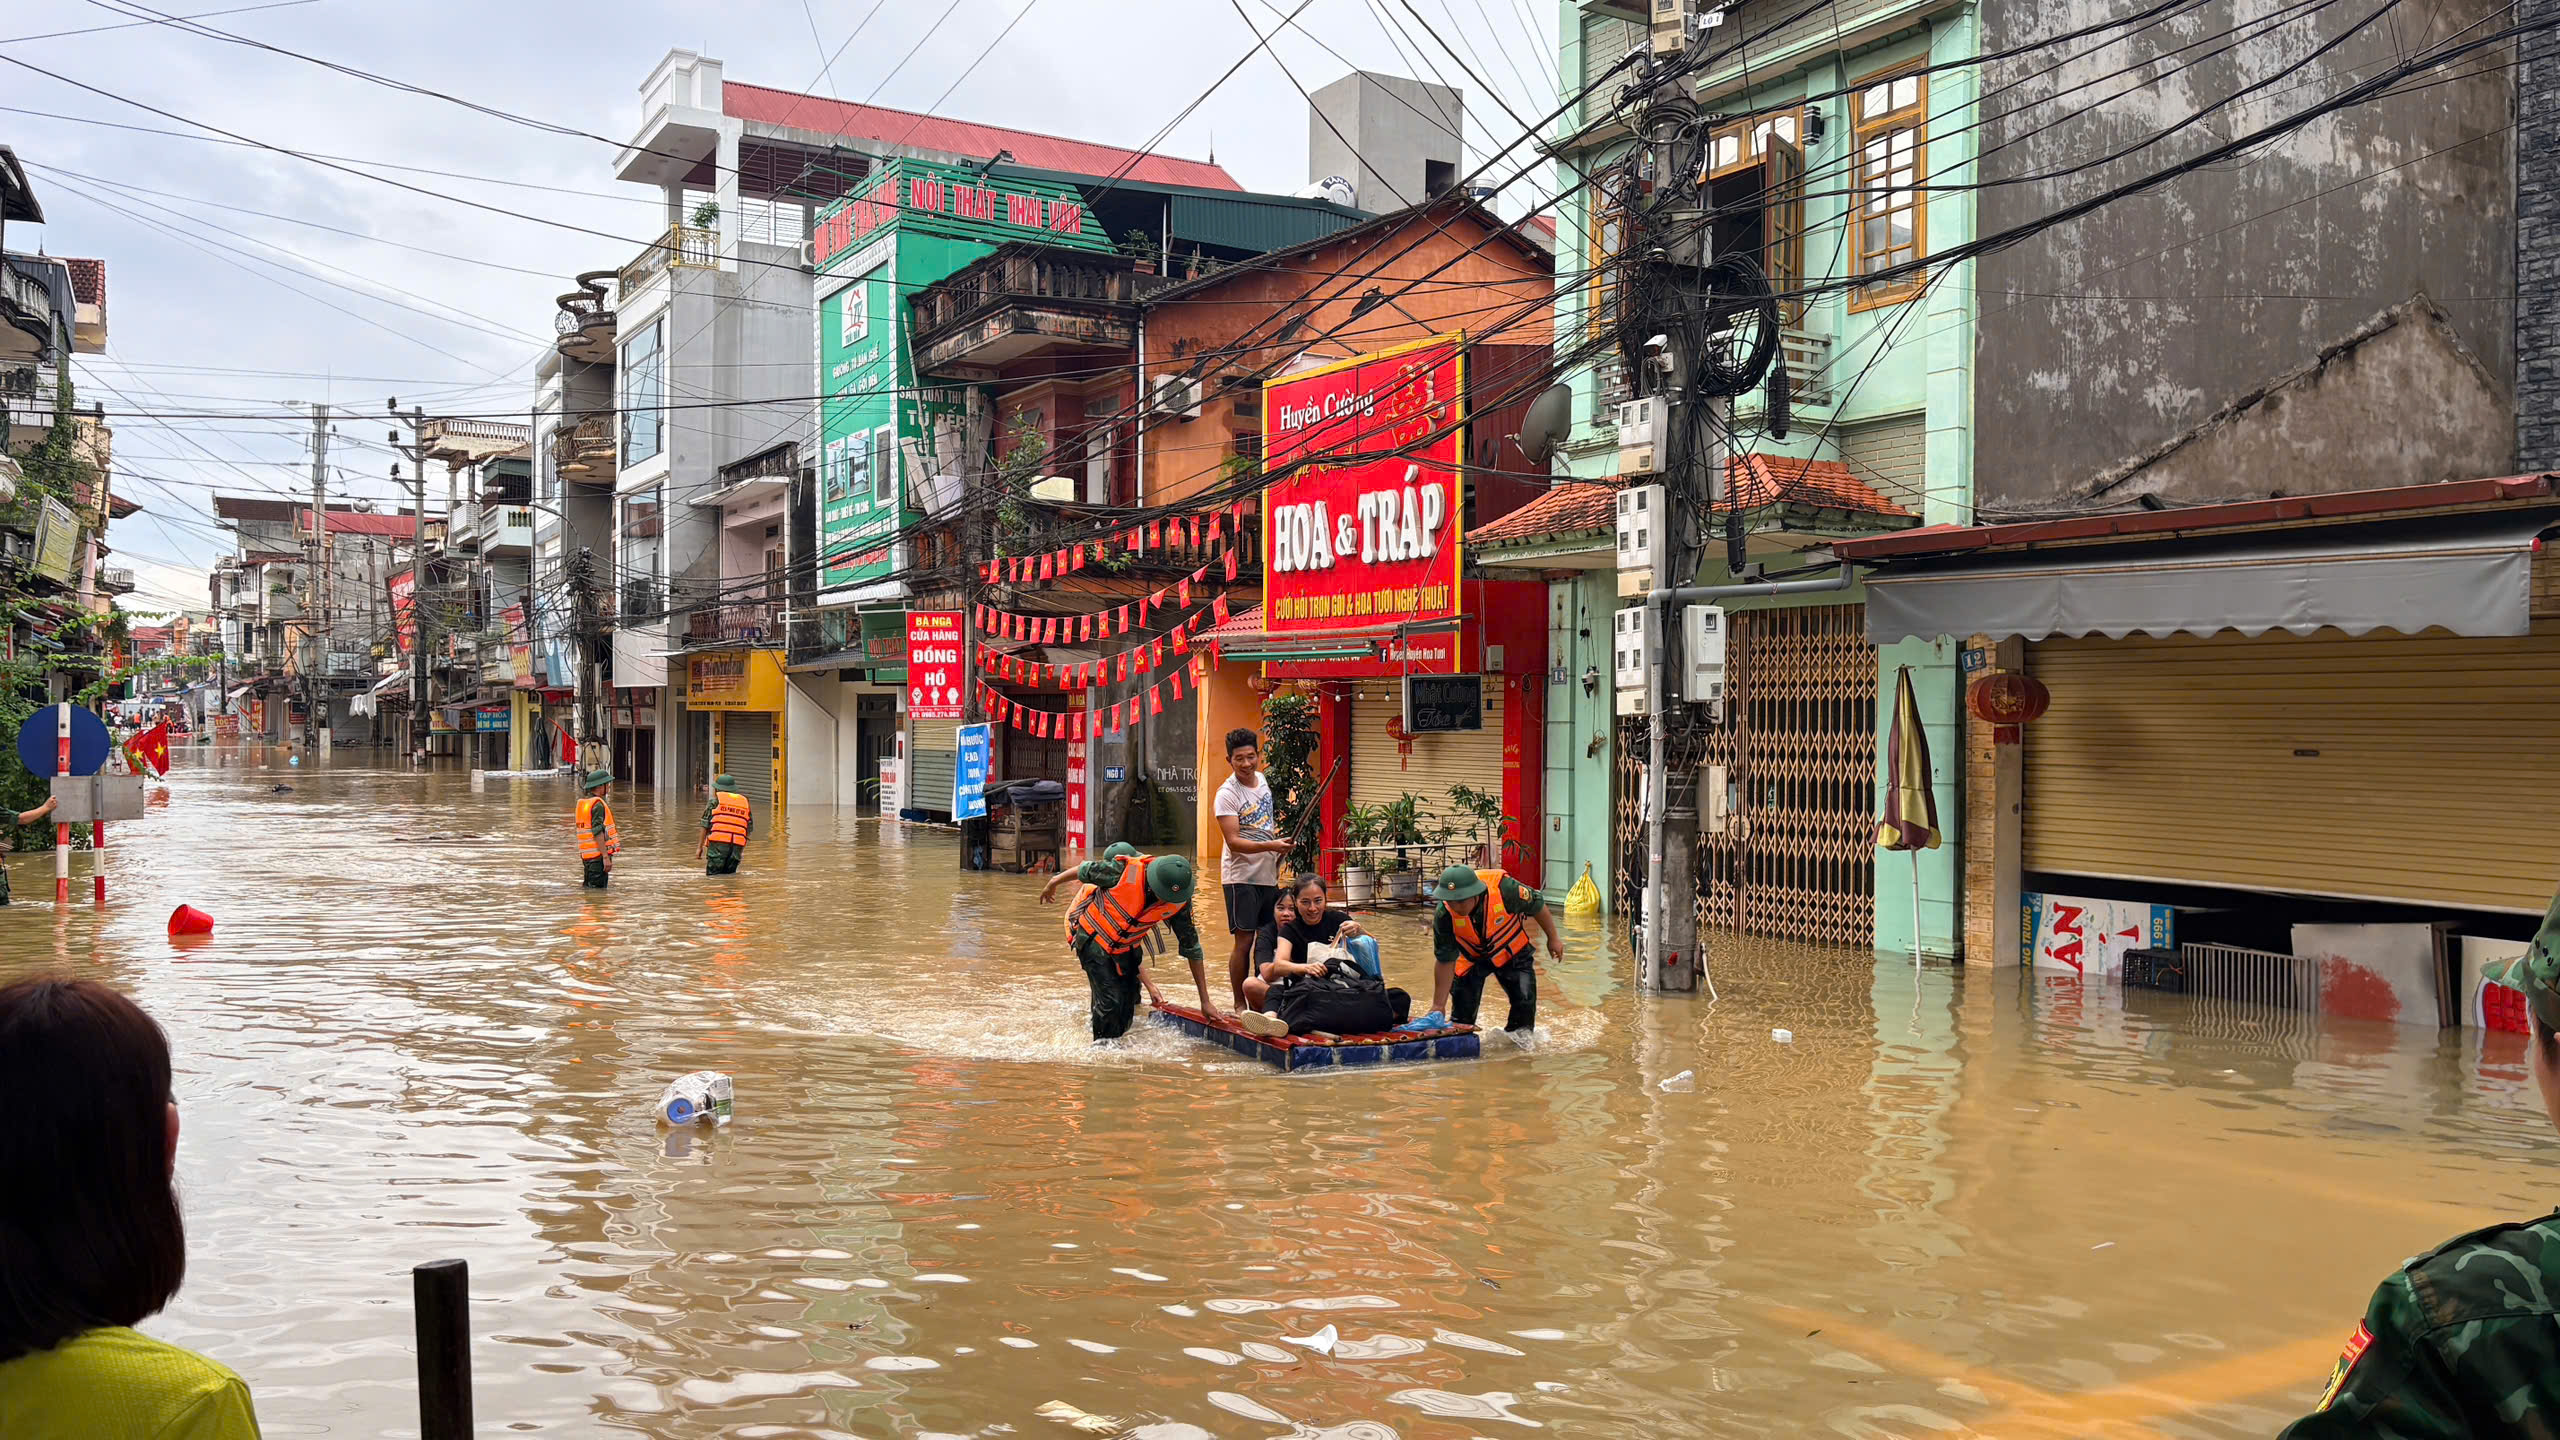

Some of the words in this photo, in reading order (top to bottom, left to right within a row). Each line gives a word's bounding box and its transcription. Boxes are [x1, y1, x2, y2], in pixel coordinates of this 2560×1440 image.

[910, 171, 945, 220] NỘI
[952, 173, 997, 221] THẤT
[1005, 189, 1043, 229] THÁI
[1048, 193, 1081, 235] VÂN
[1280, 395, 1321, 431] Huyền
[1324, 388, 1375, 420] Cường
[1273, 500, 1336, 573] HOA
[1336, 513, 1358, 557] &
[1357, 464, 1447, 565] TRÁP
[1309, 595, 1330, 623] TRỌN
[1331, 588, 1346, 617] GÓI
[1346, 593, 1355, 616] &
[1355, 592, 1372, 616] HOA
[1394, 583, 1419, 617] NGHỆ
[1420, 580, 1449, 616] THUẬT
[910, 628, 930, 641] CỬA
[932, 629, 959, 641] HÀNG
[915, 615, 930, 627] BÀ
[932, 616, 952, 627] NGA
[1964, 652, 1983, 668] 12
[1120, 768, 1123, 778] 1
[1157, 765, 1178, 781] NHÀ
[2023, 905, 2032, 945] TRUNG
